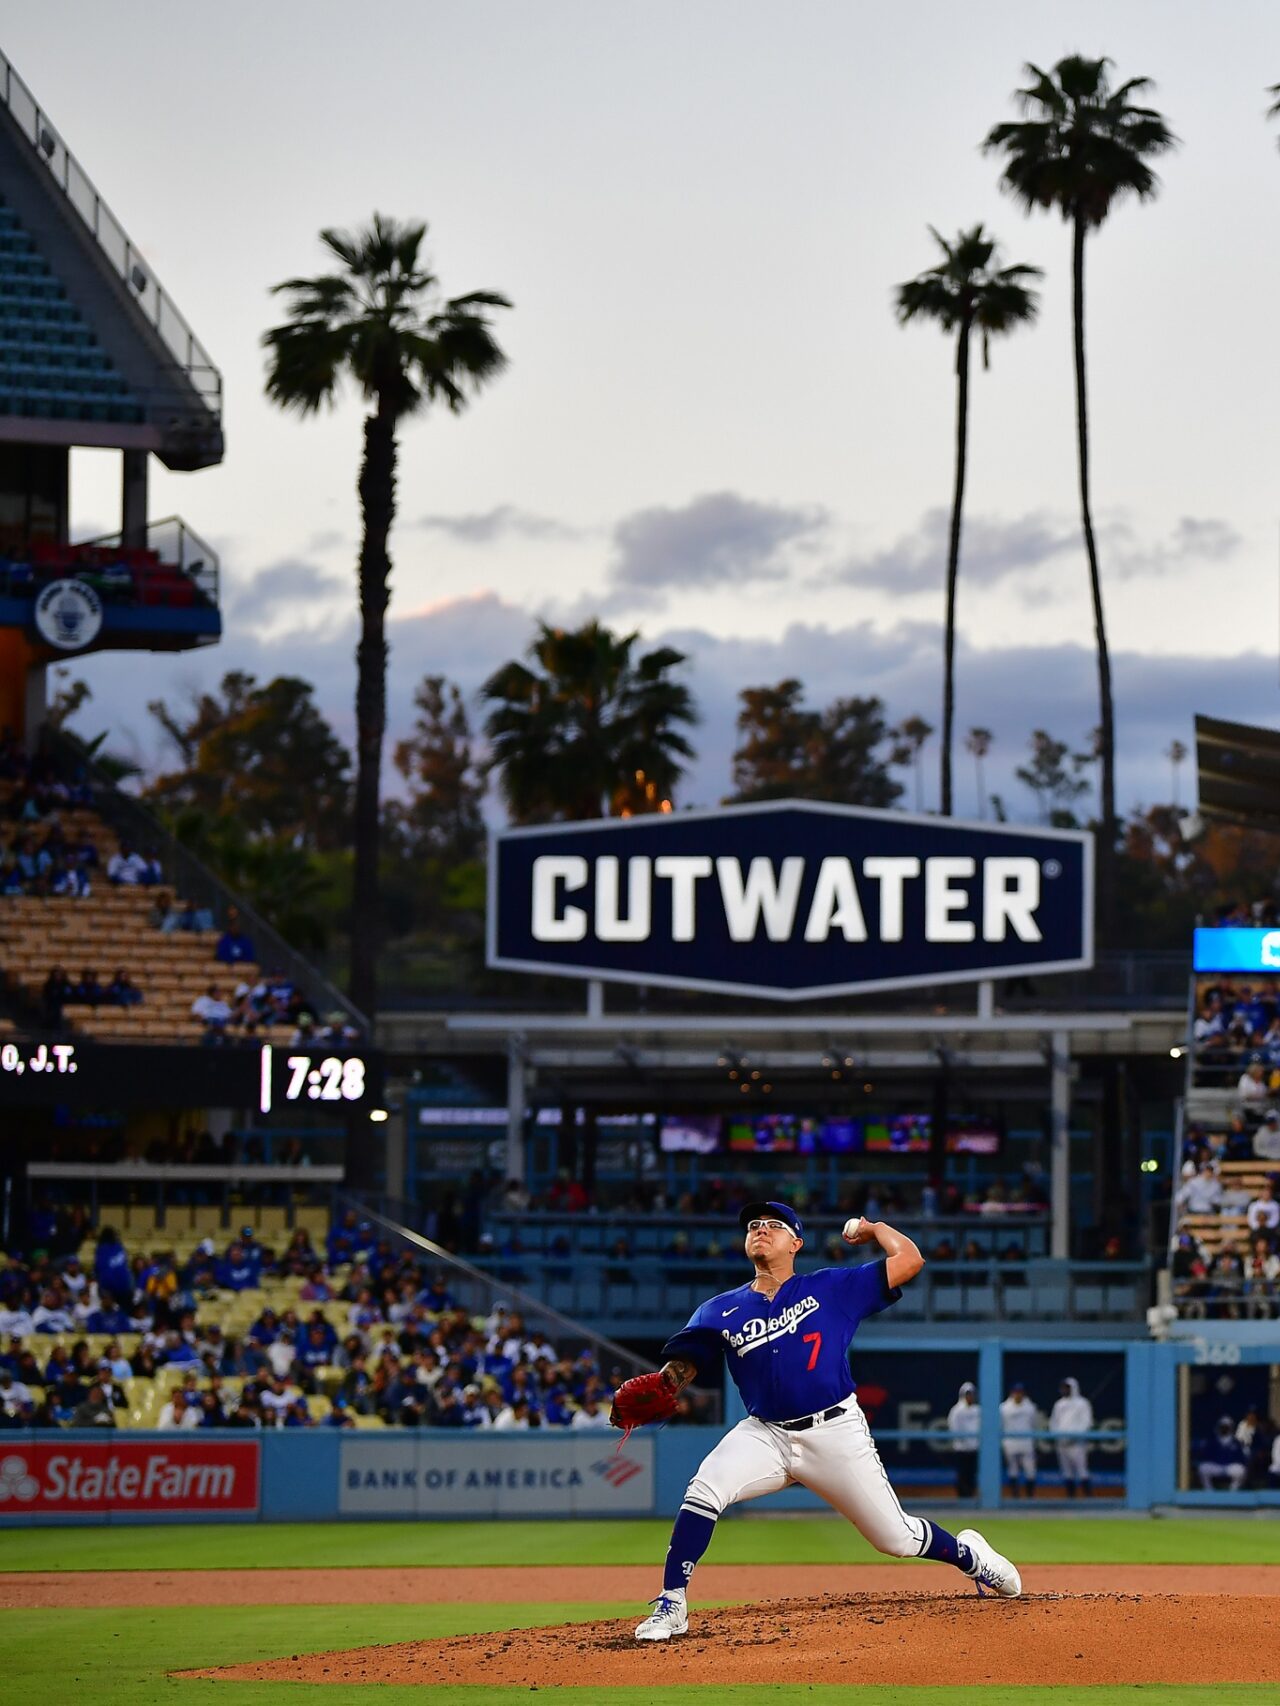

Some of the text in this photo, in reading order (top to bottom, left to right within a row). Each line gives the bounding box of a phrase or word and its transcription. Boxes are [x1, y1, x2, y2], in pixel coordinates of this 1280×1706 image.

[532, 855, 1042, 942] CUTWATER
[29, 1044, 78, 1073] J.T.
[286, 1056, 366, 1100] 7:28
[742, 1295, 820, 1342] Dodgers
[802, 1331, 822, 1371] 7
[347, 1468, 583, 1490] BANK OF AMERICA
